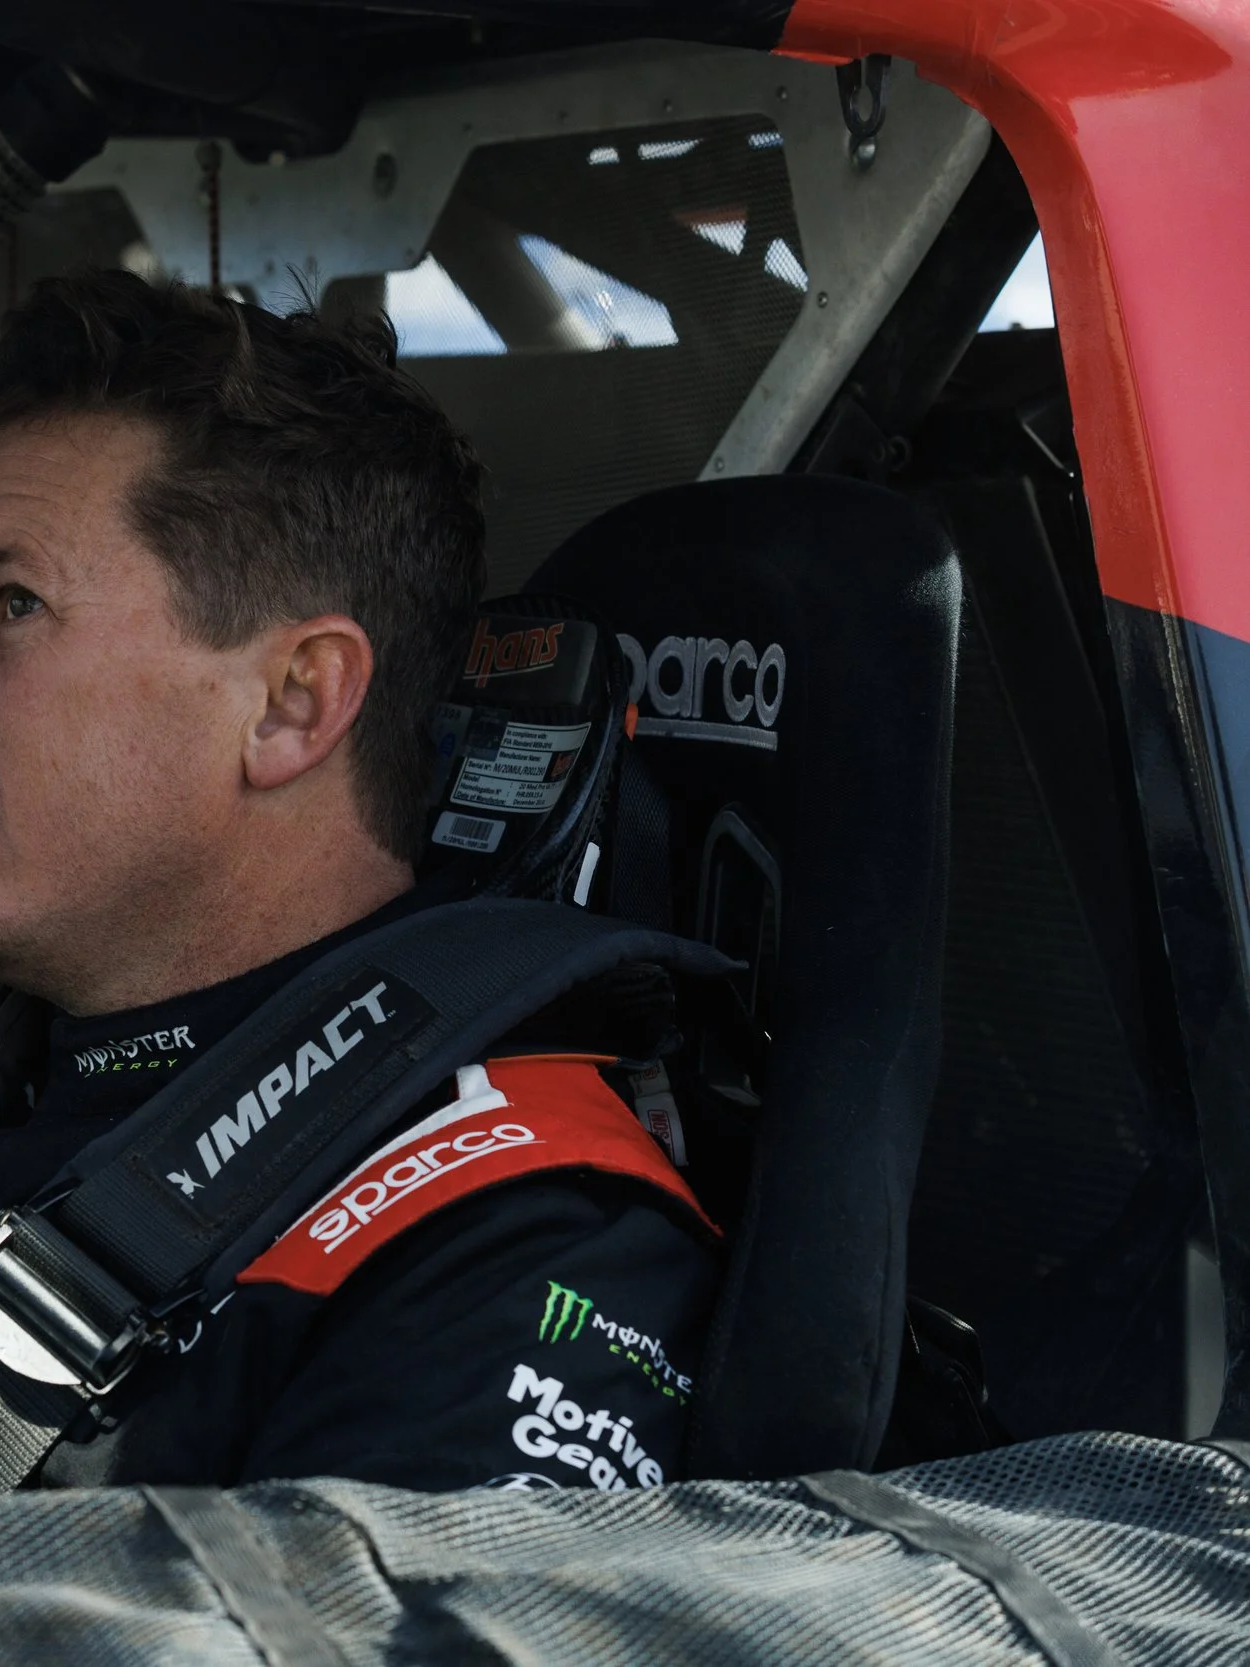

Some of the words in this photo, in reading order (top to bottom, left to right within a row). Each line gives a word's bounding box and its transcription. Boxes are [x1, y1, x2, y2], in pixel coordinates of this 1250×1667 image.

[464, 618, 565, 688] hans
[194, 981, 388, 1180] IMPACT
[308, 1122, 536, 1242] sparco
[506, 1363, 664, 1489] Motive
